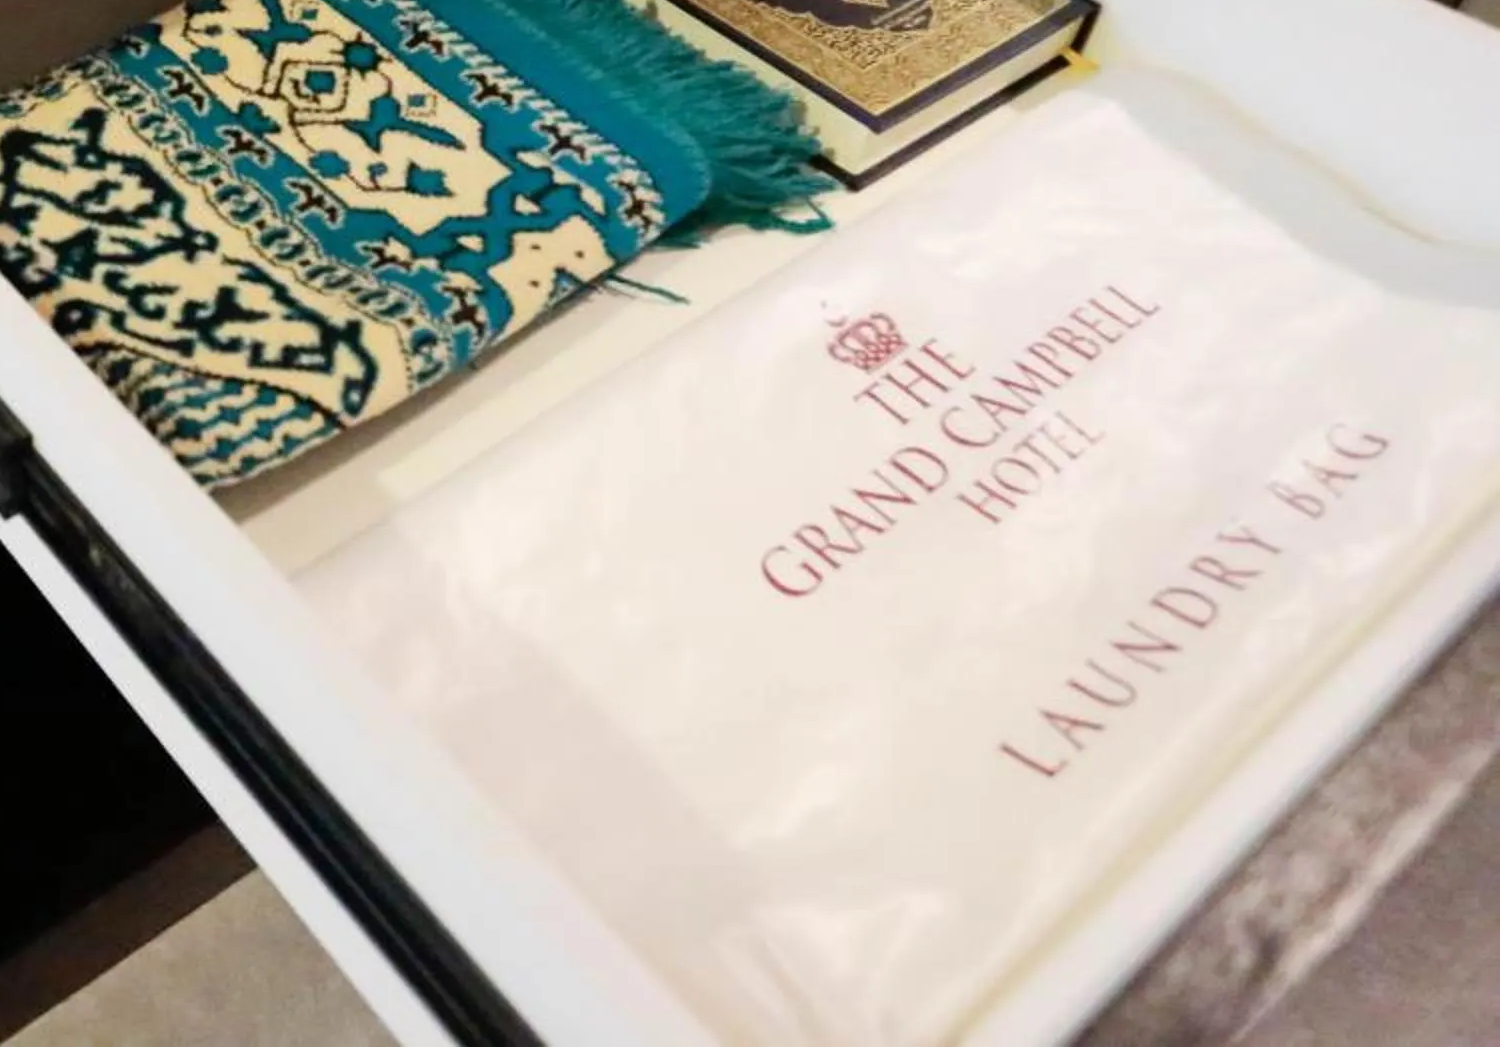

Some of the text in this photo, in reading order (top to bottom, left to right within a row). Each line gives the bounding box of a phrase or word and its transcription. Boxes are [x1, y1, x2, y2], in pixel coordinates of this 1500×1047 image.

[760, 285, 1161, 597] GRAND CAMPBELL
[853, 338, 975, 425] THE
[957, 408, 1104, 524] HOTEL
[998, 423, 1390, 778] LAUNDRY BAG
